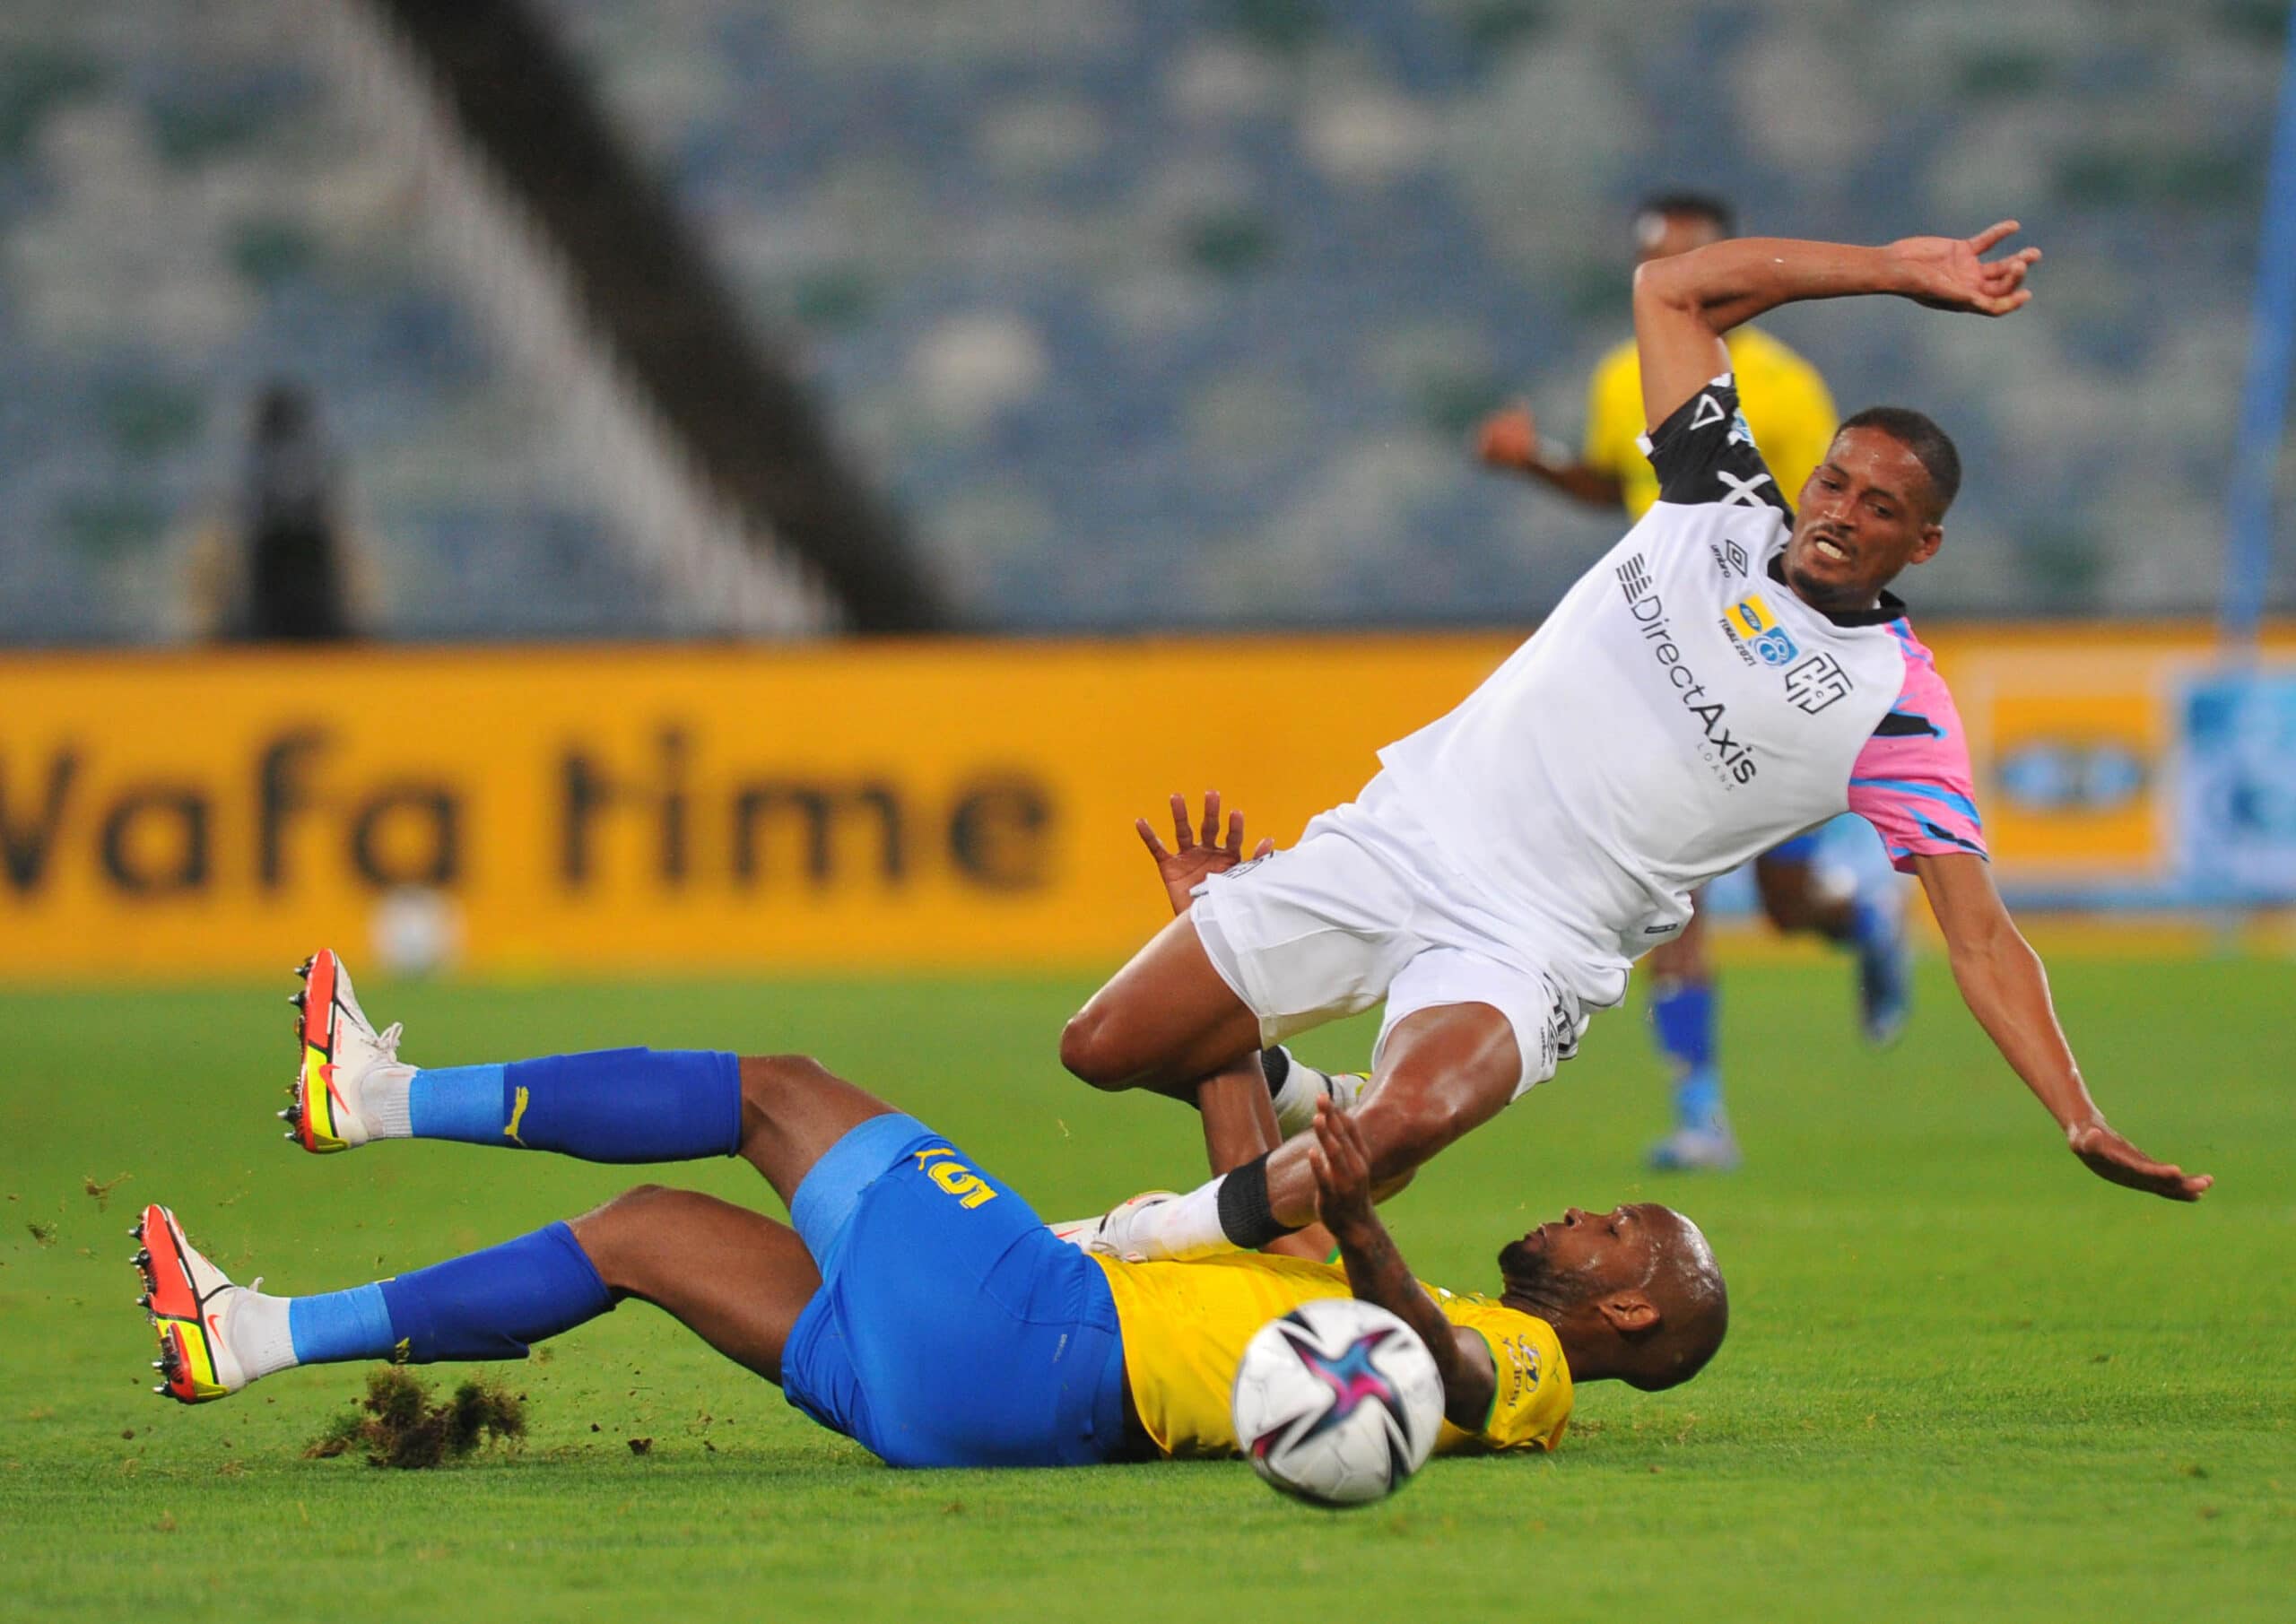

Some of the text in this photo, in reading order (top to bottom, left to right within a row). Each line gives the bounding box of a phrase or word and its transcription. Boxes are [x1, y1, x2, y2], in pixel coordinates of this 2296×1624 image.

[1710, 544, 1731, 578] umbro
[1718, 618, 1758, 667] FINAL 2021
[1631, 595, 1757, 785] DirectAxis
[1696, 743, 1735, 792] LOANS
[558, 723, 1058, 890] time
[927, 1161, 997, 1209] 5
